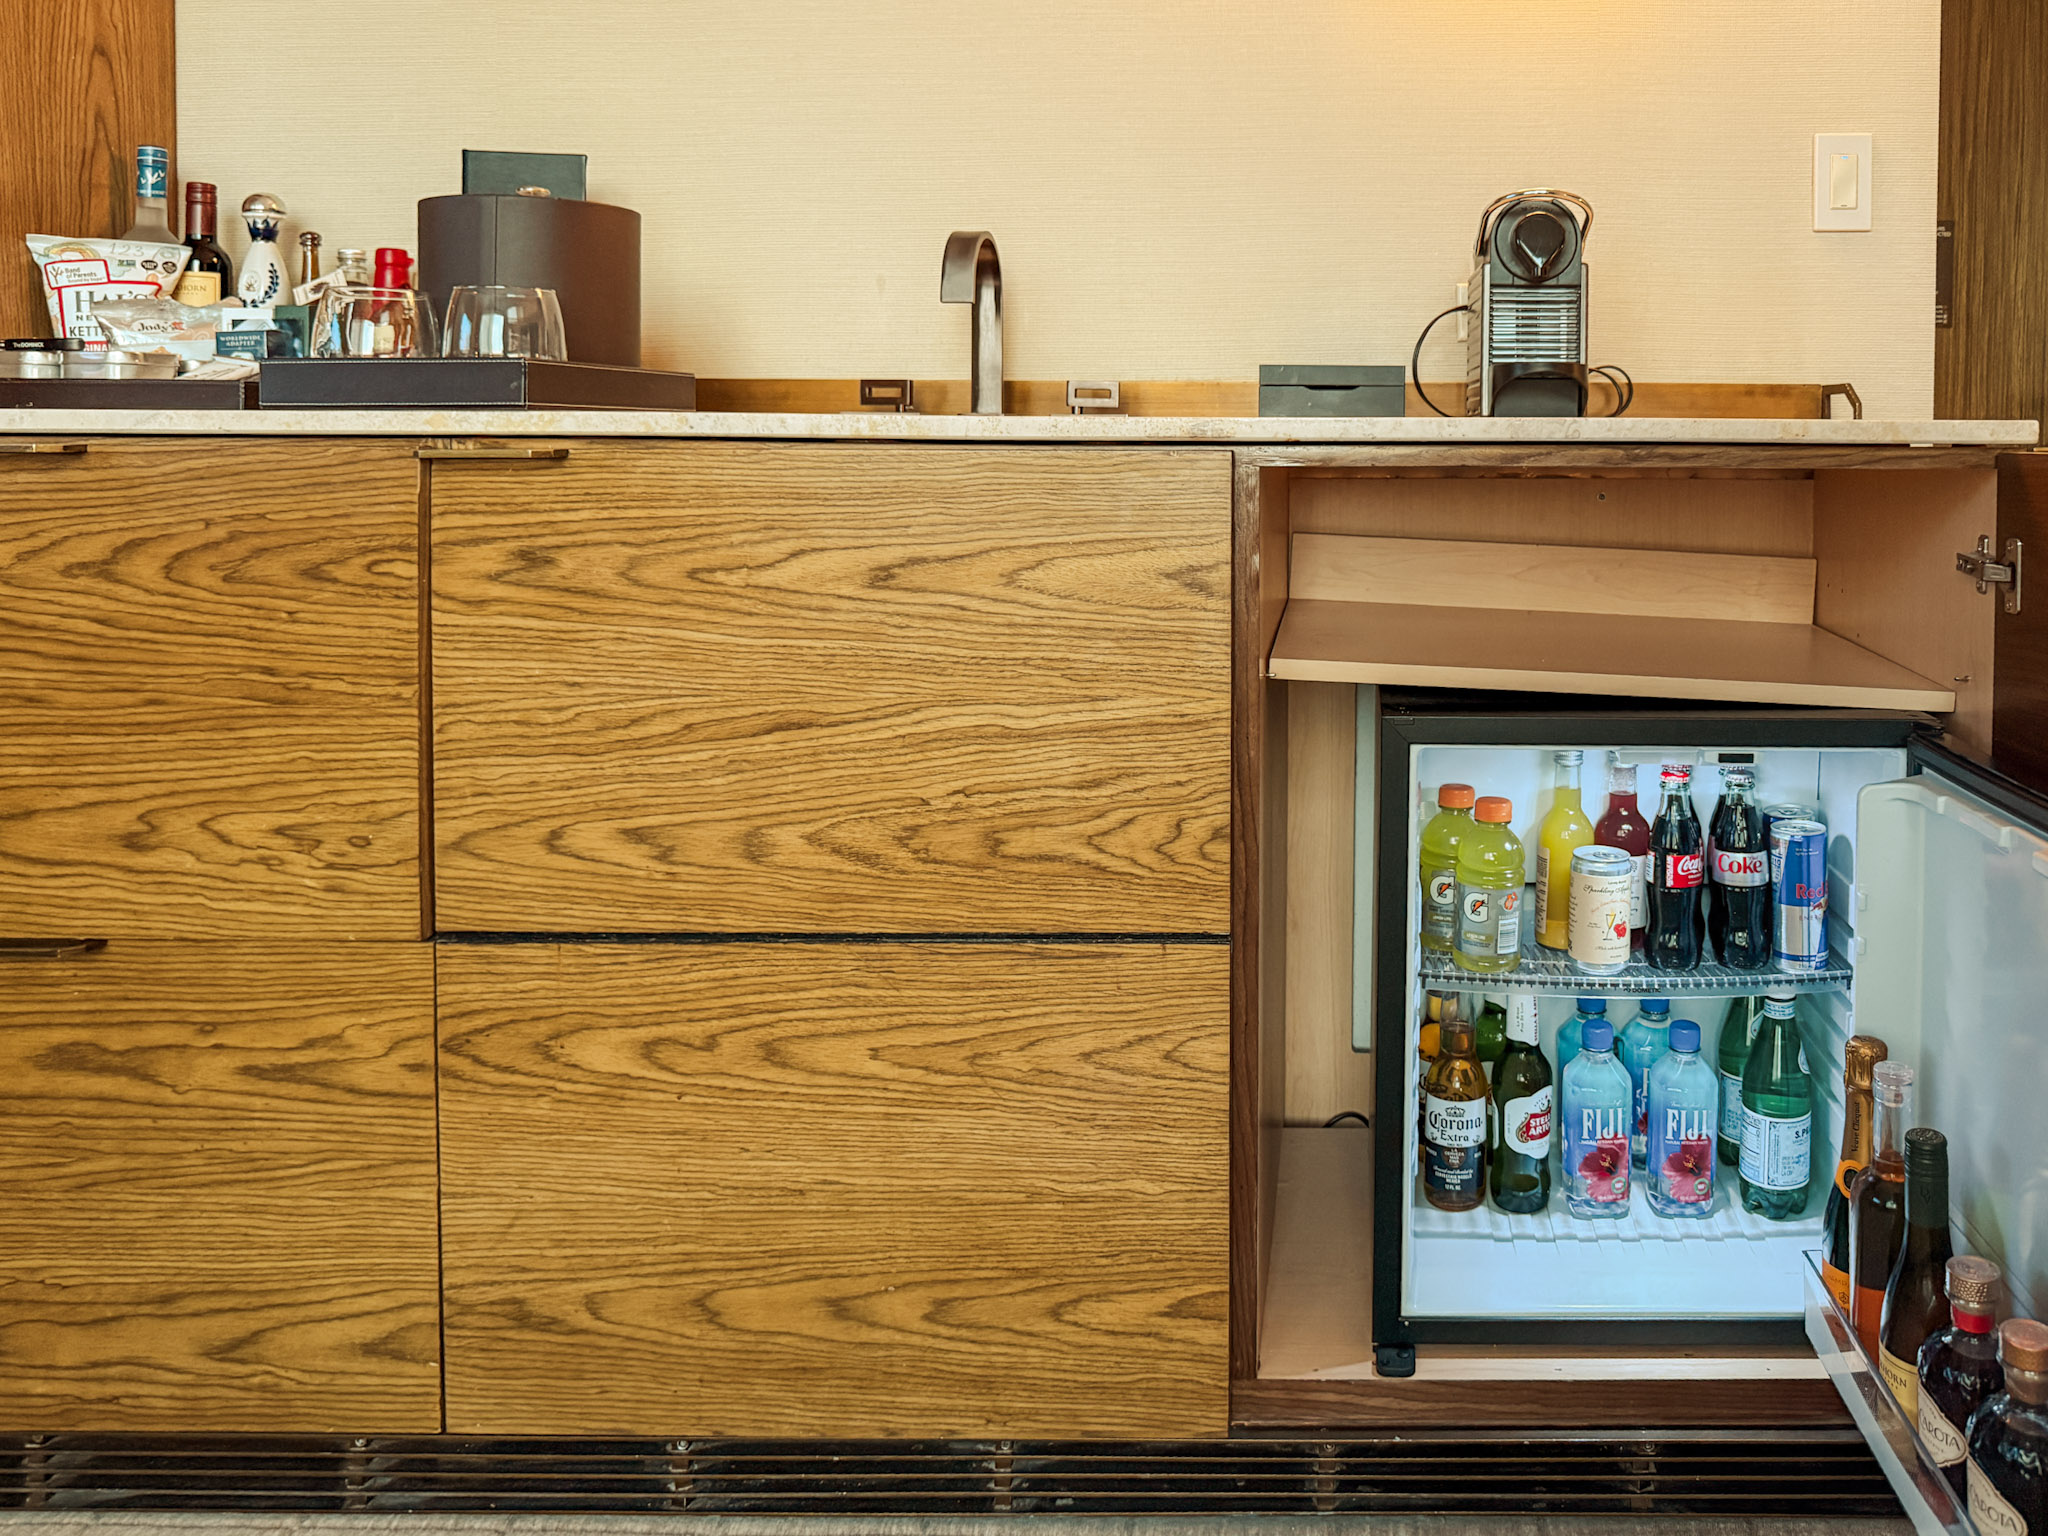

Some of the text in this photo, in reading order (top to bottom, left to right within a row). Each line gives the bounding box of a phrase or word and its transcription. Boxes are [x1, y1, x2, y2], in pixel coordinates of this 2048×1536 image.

[69, 326, 104, 337] KETT
[1718, 853, 1763, 874] Coke
[1429, 875, 1456, 905] G
[1795, 883, 1825, 900] Red
[1463, 891, 1489, 923] G
[1429, 1110, 1483, 1133] Corona
[1581, 1107, 1625, 1140] FIJI
[1665, 1108, 1709, 1140] FIJI
[1851, 1102, 1861, 1152] Veuve Clicquot
[1440, 1129, 1469, 1142] Extra
